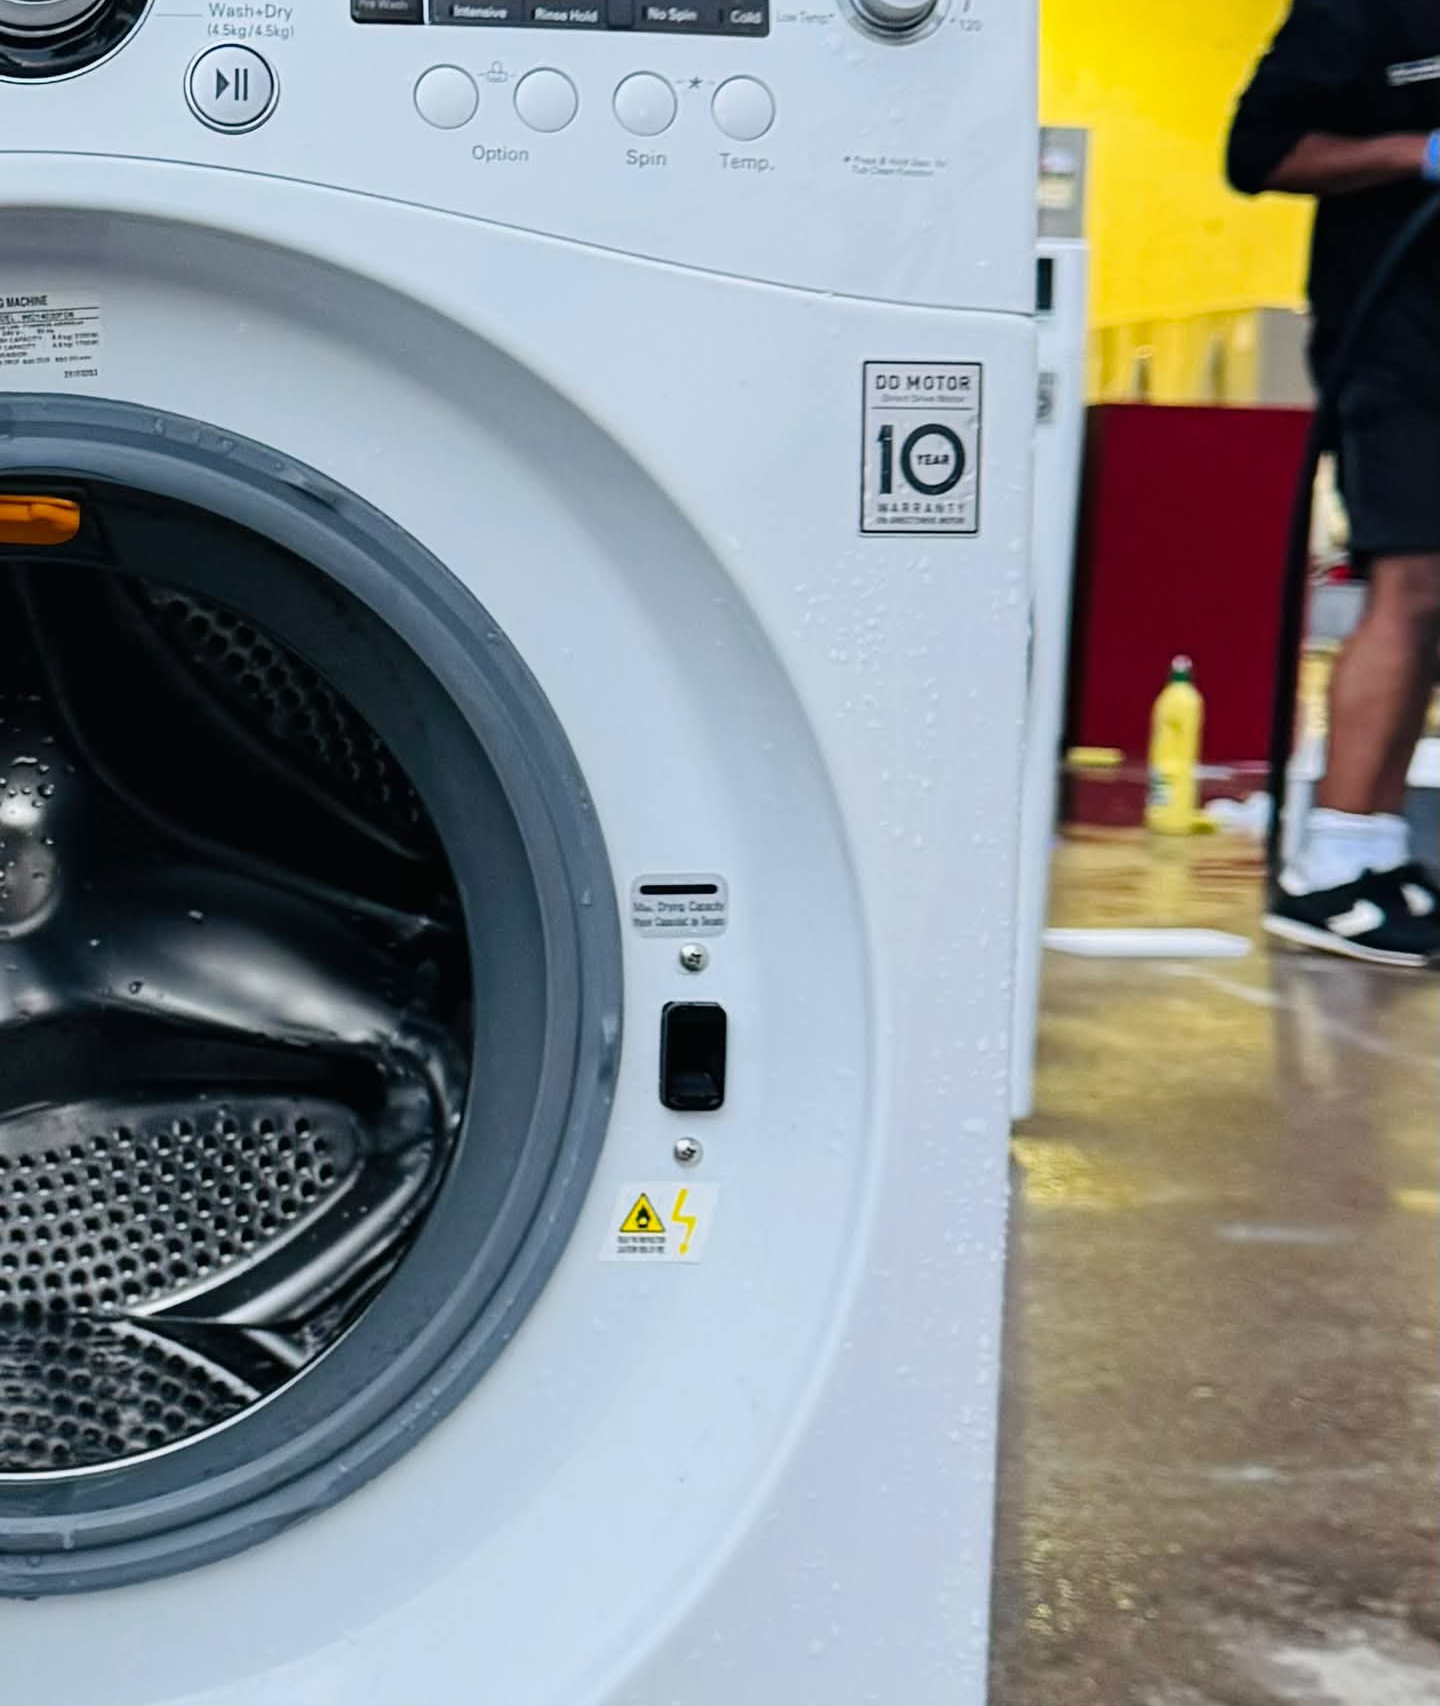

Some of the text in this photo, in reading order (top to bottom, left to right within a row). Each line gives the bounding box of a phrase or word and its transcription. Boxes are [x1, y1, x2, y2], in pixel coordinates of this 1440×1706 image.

[208, 2, 293, 22] Wash+Dry
[647, 5, 699, 23] No Spin
[730, 8, 763, 25] Cold
[471, 144, 530, 163] Option
[625, 148, 668, 168] Spin
[720, 151, 776, 173] Temp.
[6, 294, 49, 308] MACHINE
[875, 374, 972, 392] DD MOTOR
[877, 423, 966, 496] 10
[916, 453, 950, 466] YEAR
[877, 502, 966, 514] WARRANTY
